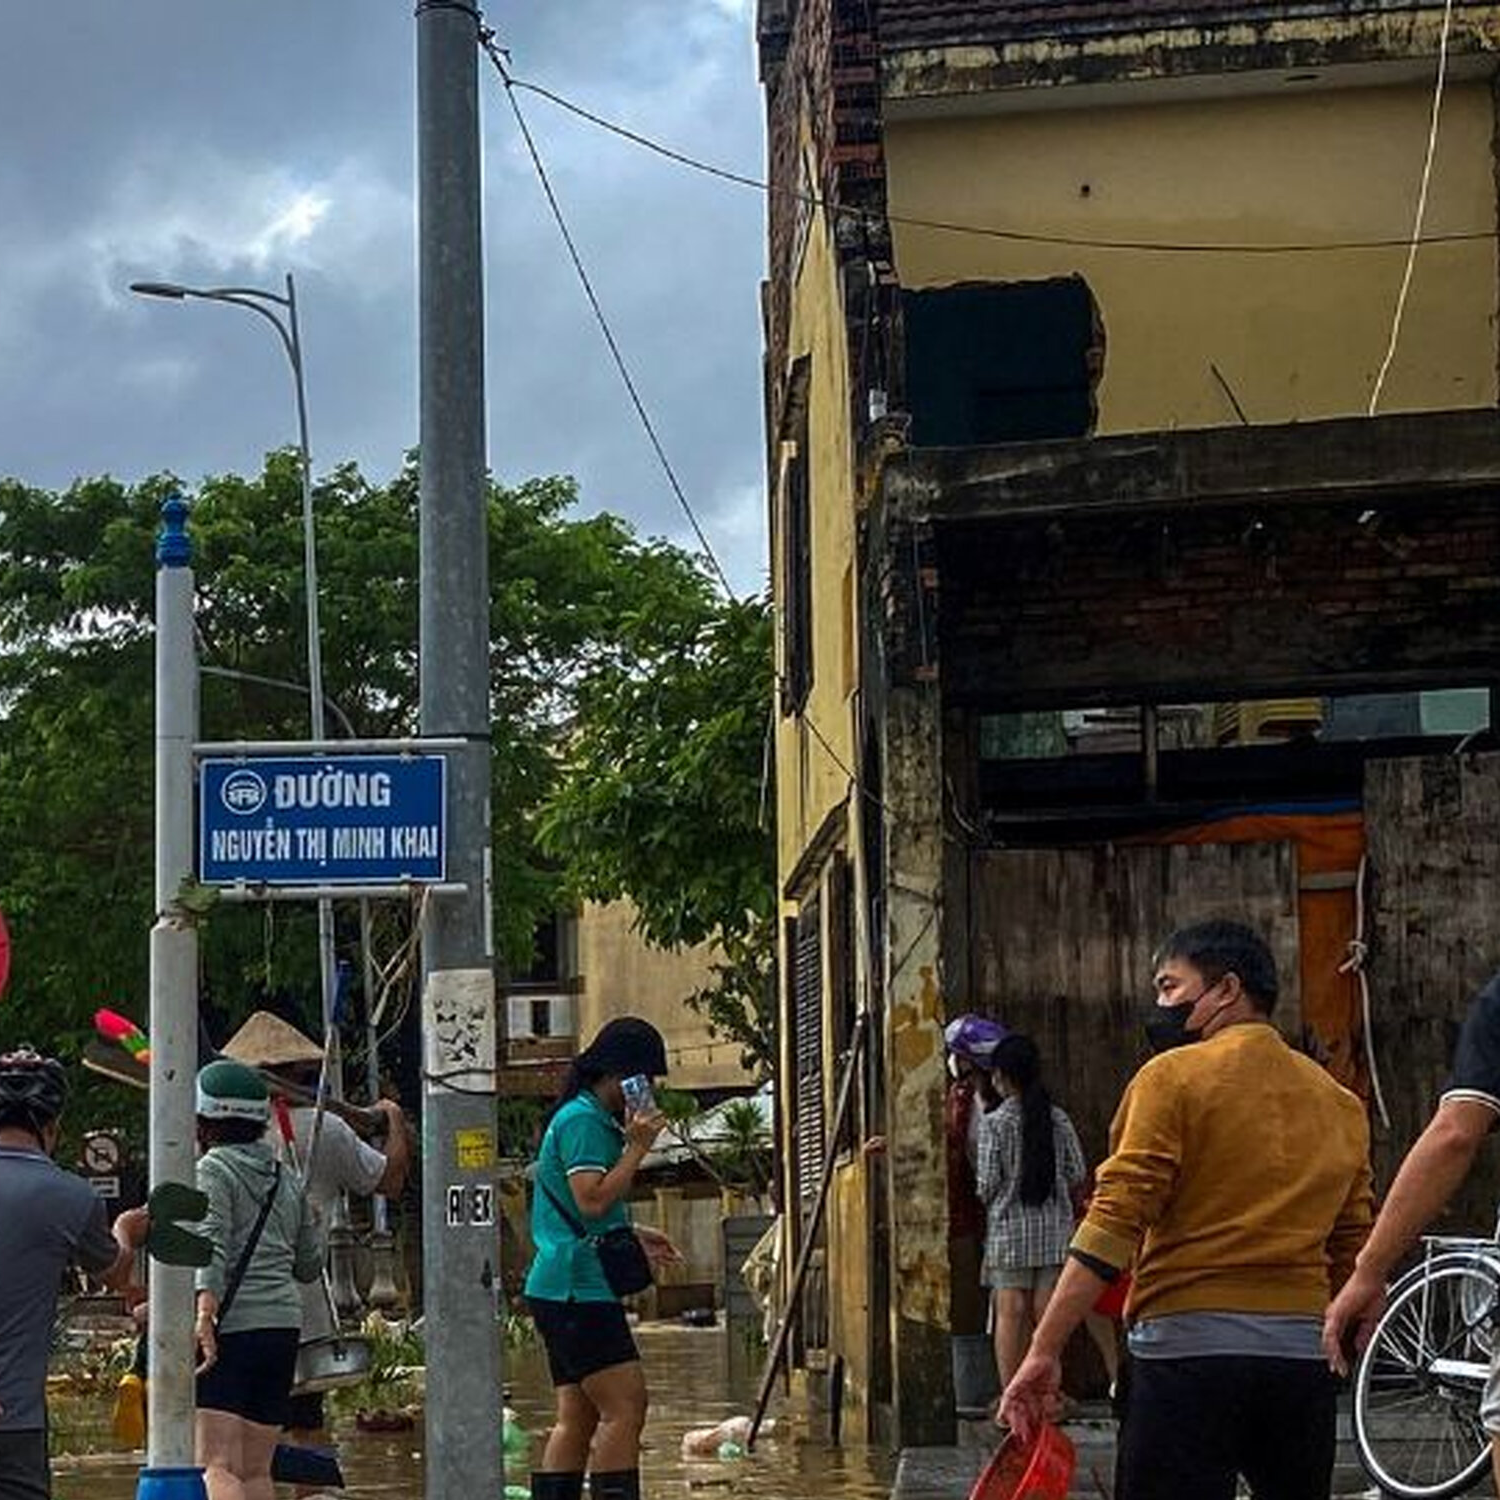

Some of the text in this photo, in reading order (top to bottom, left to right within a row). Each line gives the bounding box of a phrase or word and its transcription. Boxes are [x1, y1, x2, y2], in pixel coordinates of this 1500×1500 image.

[274, 764, 391, 808] ĐƯỜNG
[296, 827, 327, 866] THỊ
[332, 826, 385, 860] MINH
[390, 825, 438, 859] KHAI
